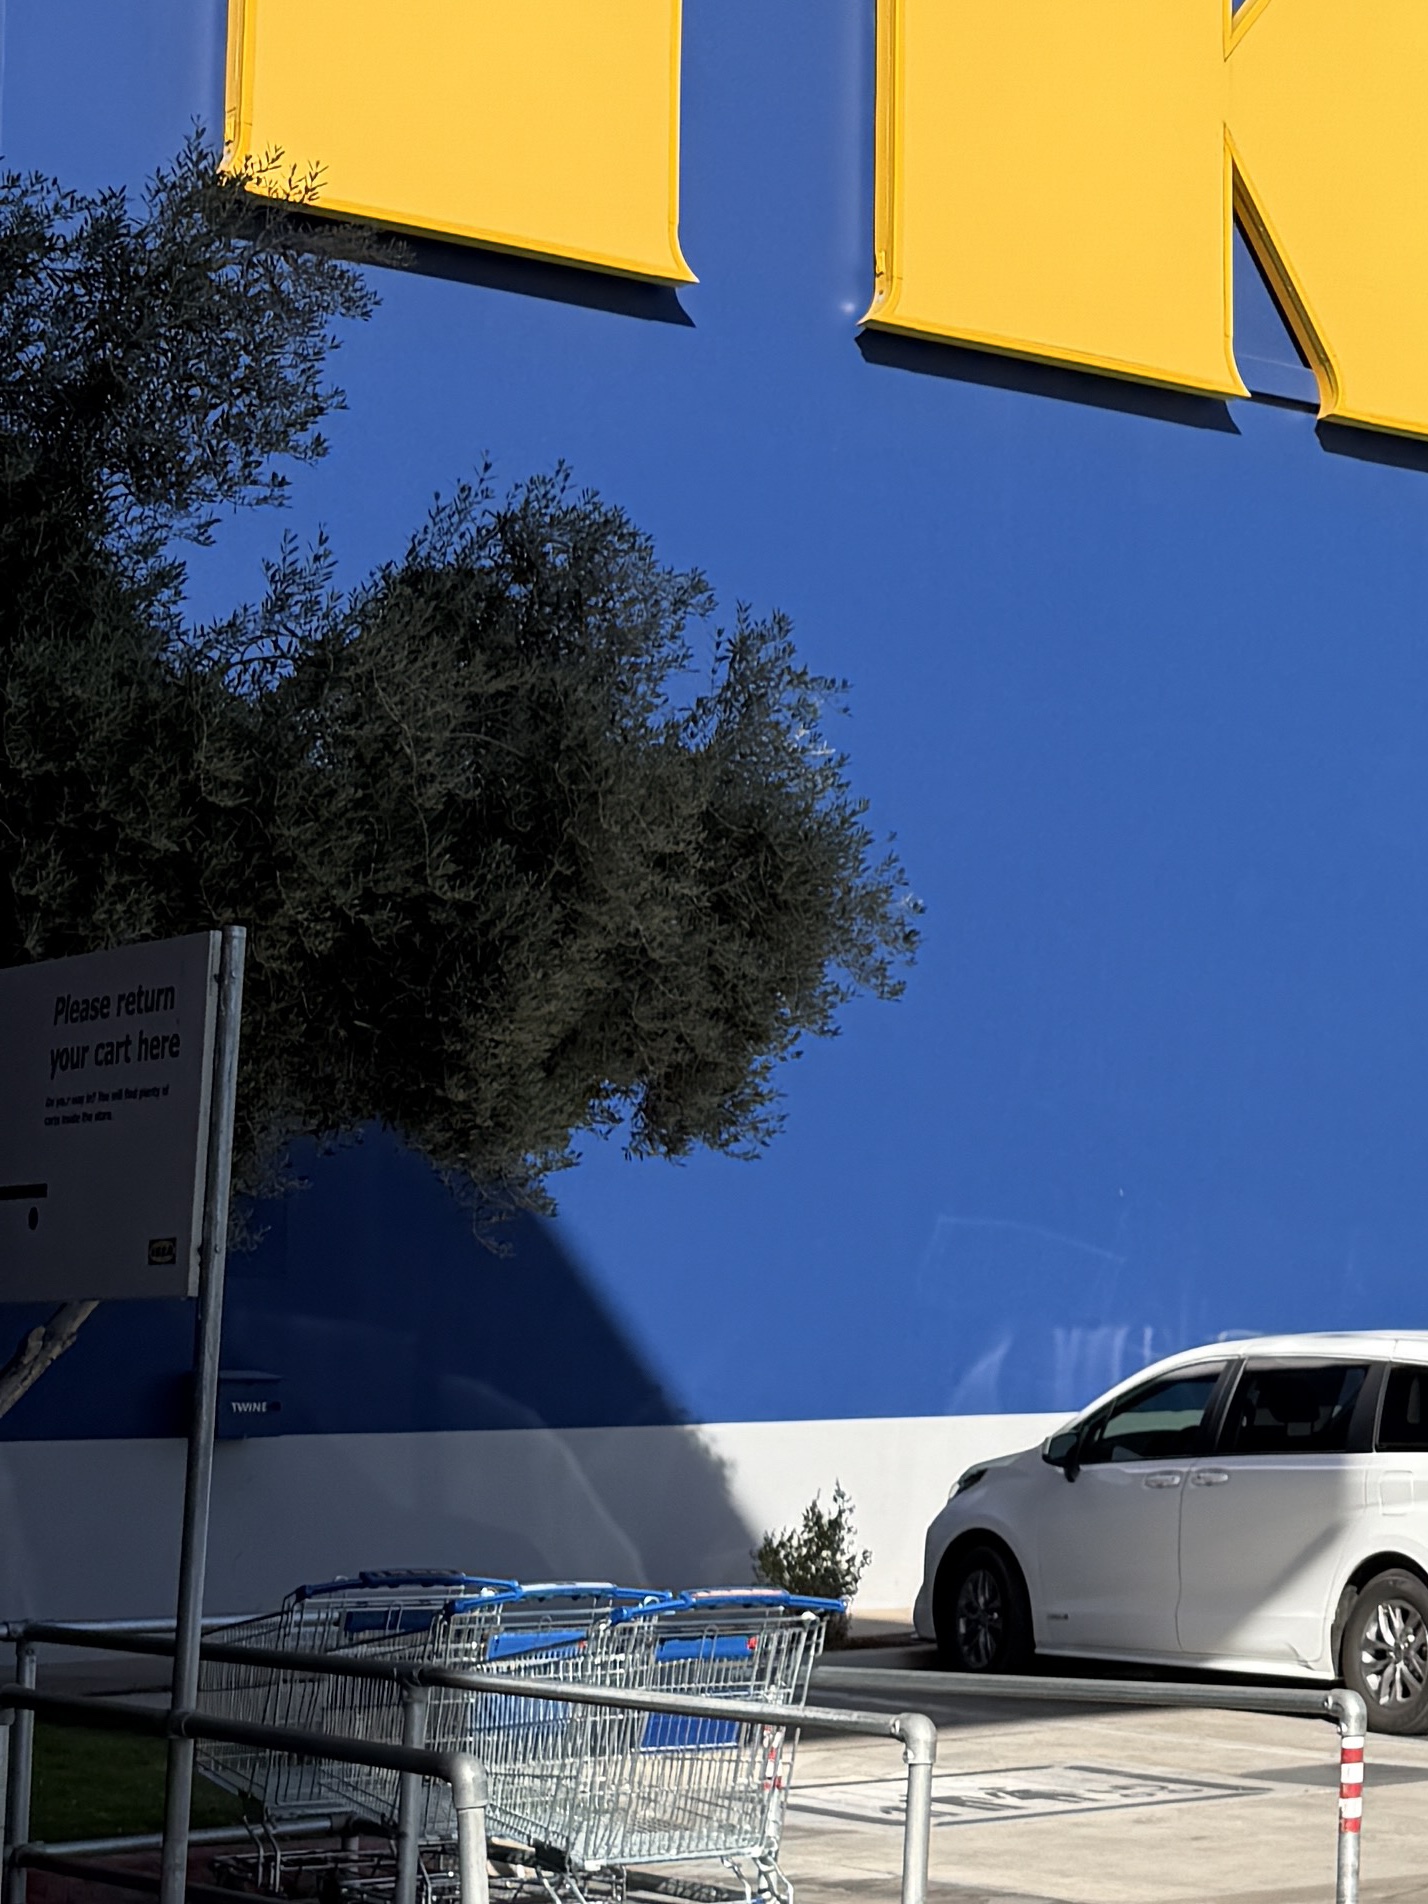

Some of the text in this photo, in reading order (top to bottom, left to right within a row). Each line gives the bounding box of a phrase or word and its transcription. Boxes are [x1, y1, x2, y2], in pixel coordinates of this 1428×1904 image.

[53, 985, 175, 1026] Please return
[50, 1029, 181, 1080] your cart here
